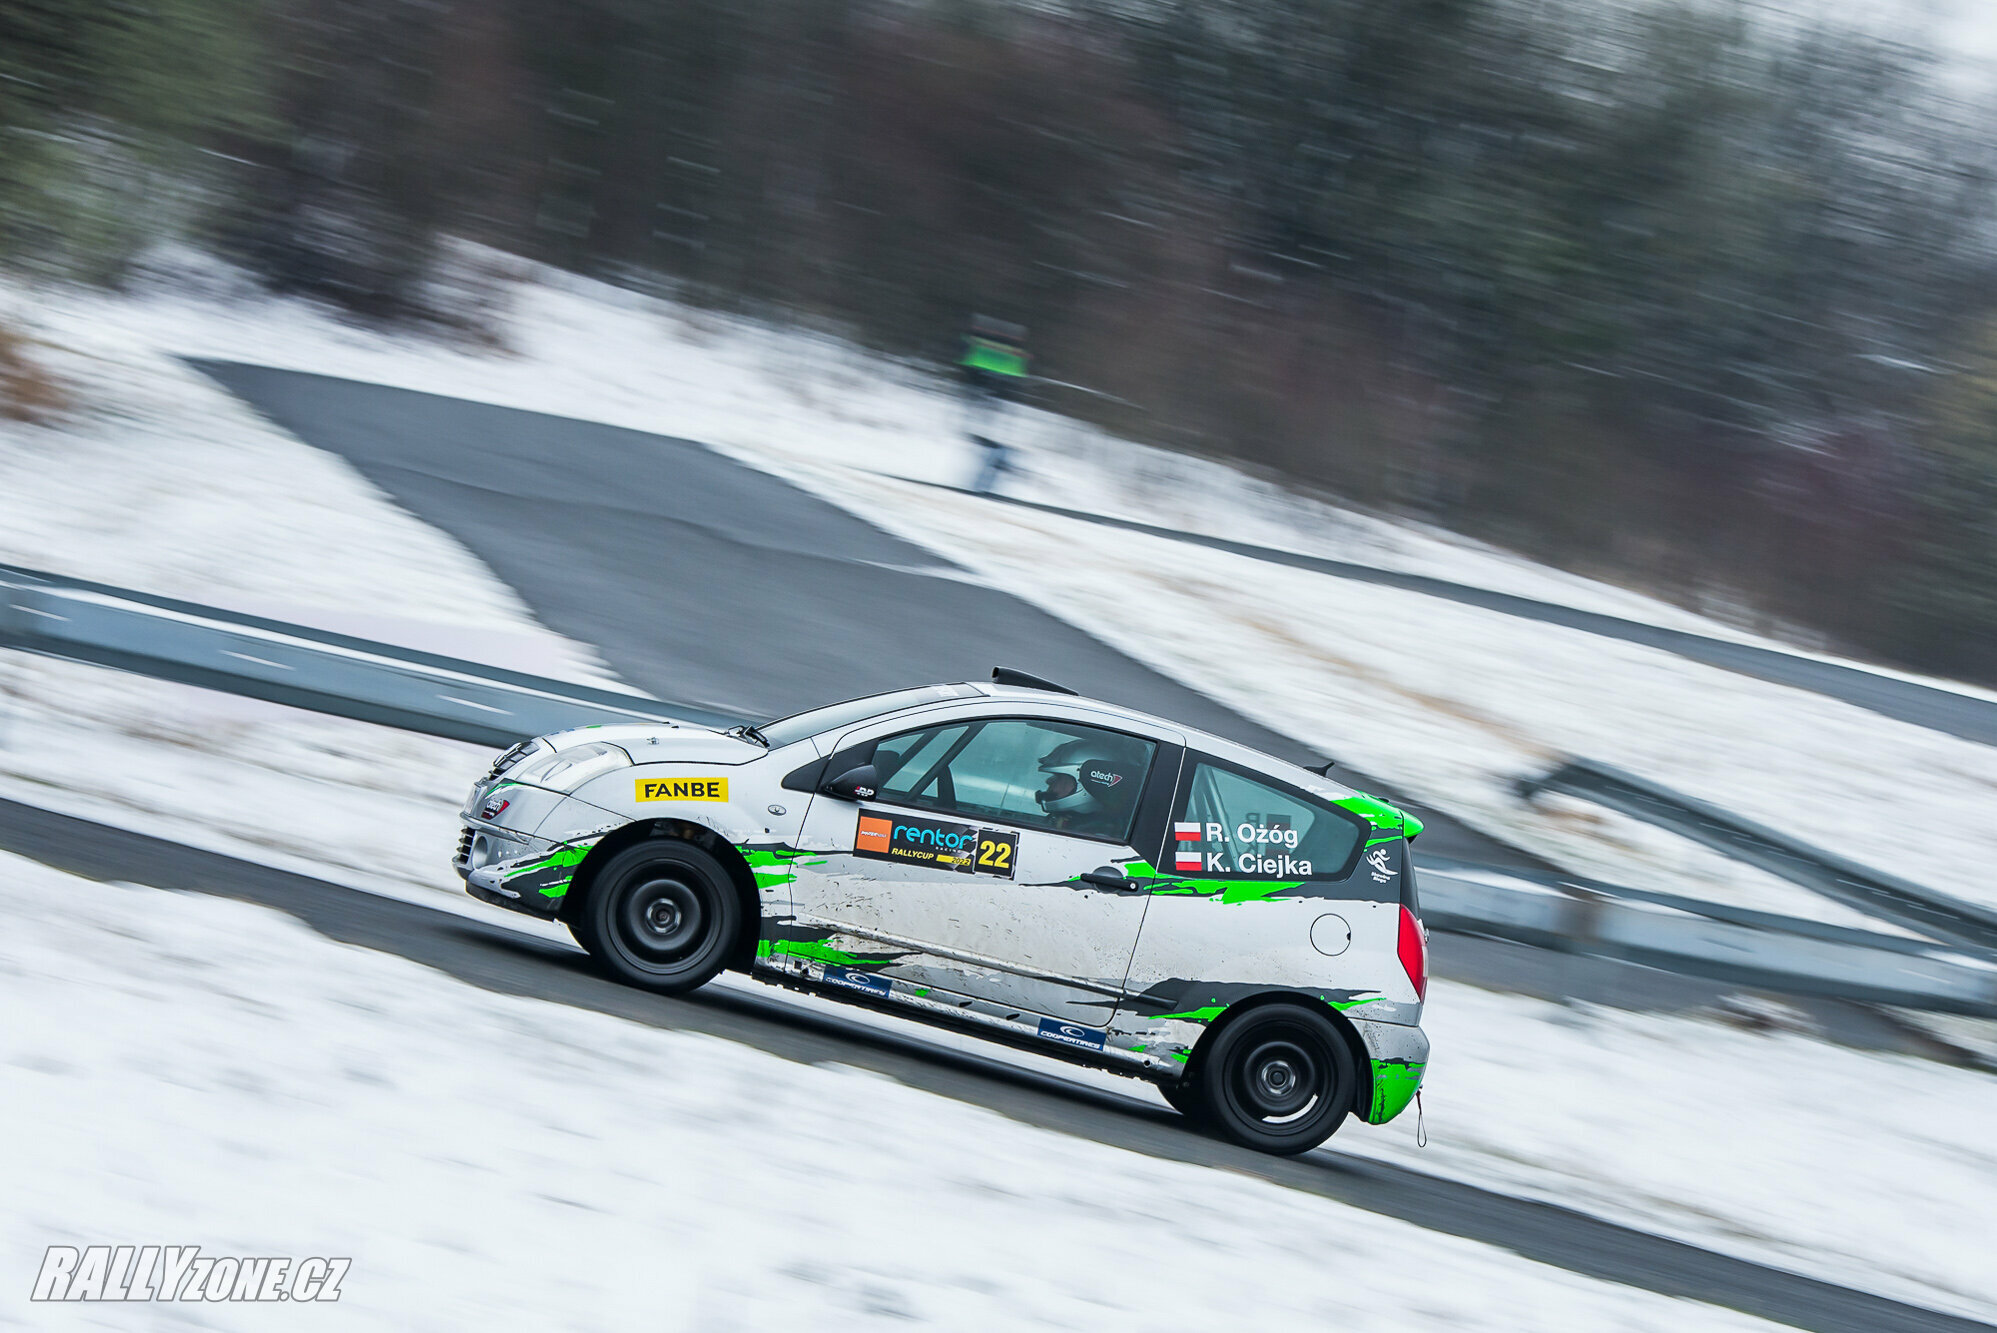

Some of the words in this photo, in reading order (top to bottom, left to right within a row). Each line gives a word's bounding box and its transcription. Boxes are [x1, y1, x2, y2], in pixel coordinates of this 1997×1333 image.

[644, 782, 720, 798] FANBE
[893, 825, 974, 850] rentor
[1205, 822, 1230, 842] R.
[1237, 823, 1298, 849] Ożóg
[891, 847, 935, 860] RALLYCUP
[978, 840, 1012, 869] 22
[1206, 852, 1231, 873] K.
[1238, 852, 1313, 879] Ciejka
